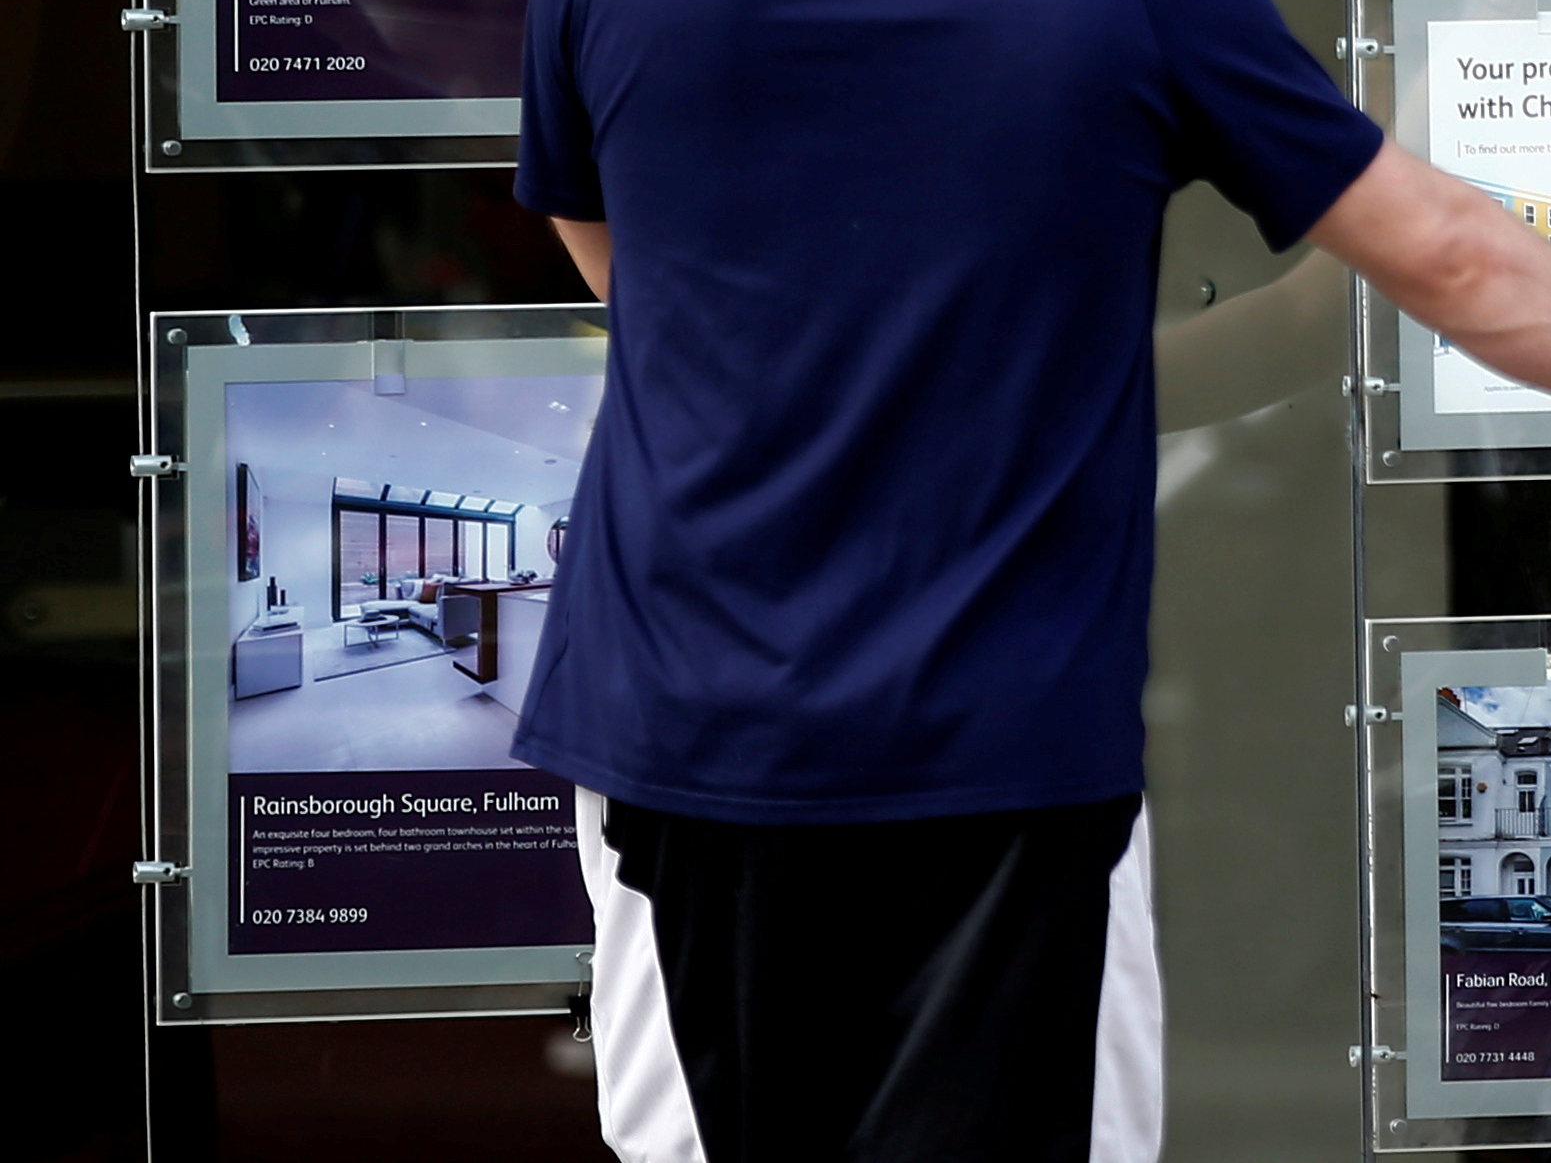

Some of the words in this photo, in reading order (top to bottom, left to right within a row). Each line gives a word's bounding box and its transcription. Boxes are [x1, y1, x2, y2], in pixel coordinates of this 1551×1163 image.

[249, 57, 279, 71] 020
[283, 57, 319, 70] 7471
[326, 56, 365, 70] 2020
[1457, 58, 1514, 80] Your
[1457, 96, 1513, 118] with
[1463, 144, 1476, 155] To
[1478, 144, 1497, 154] find
[1499, 144, 1516, 154] out
[1518, 145, 1544, 153] more
[253, 795, 394, 818] Rainsborough
[401, 793, 477, 816] Square,
[483, 792, 558, 811] Fulham
[252, 909, 282, 924] 020
[286, 909, 324, 923] 7384
[329, 908, 367, 923] 9899
[1456, 973, 1504, 987] Fabian
[1508, 972, 1547, 986] Road,
[1455, 1052, 1476, 1063] 020
[1479, 1052, 1504, 1062] 7731
[1508, 1051, 1534, 1061] 4448
